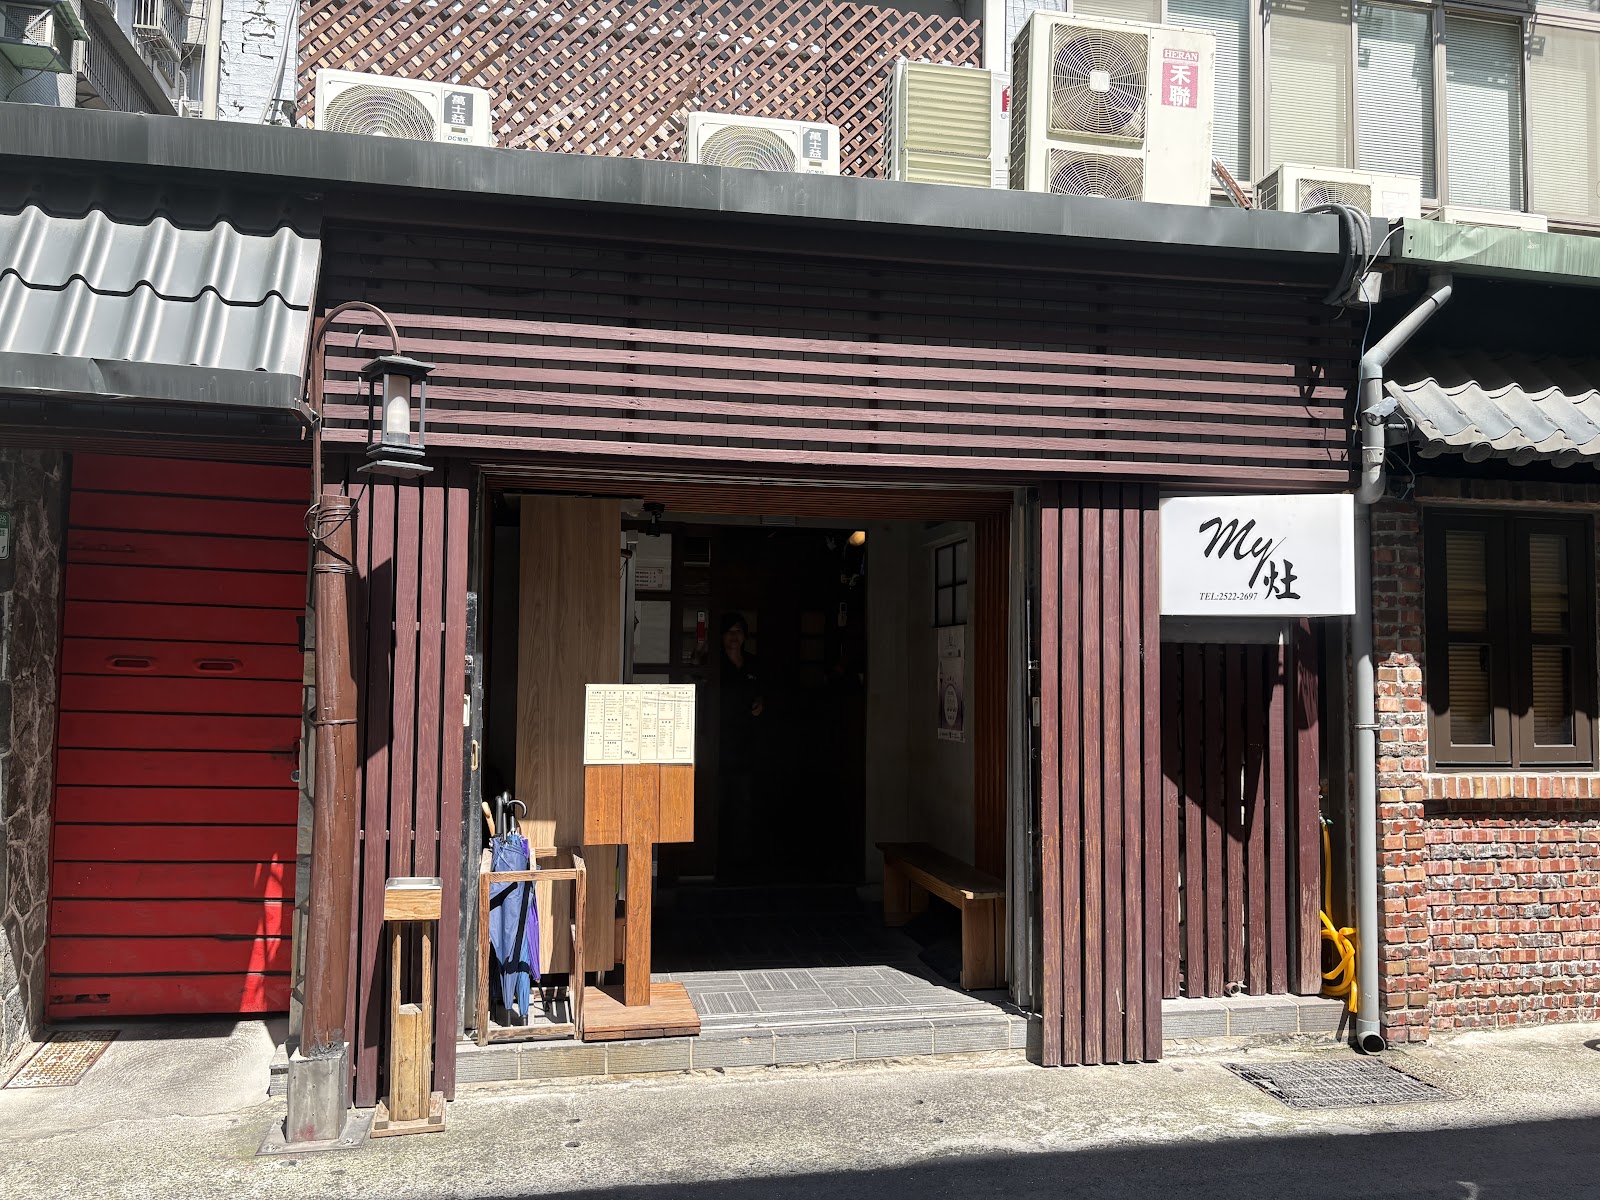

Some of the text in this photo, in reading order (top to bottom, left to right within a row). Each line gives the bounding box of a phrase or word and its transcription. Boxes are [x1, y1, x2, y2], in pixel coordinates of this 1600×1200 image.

[1164, 49, 1198, 61] HERAN
[1169, 65, 1192, 107] 禾聯
[451, 94, 467, 125] 萬士益
[1199, 592, 1258, 601] TEL:2522-2697
